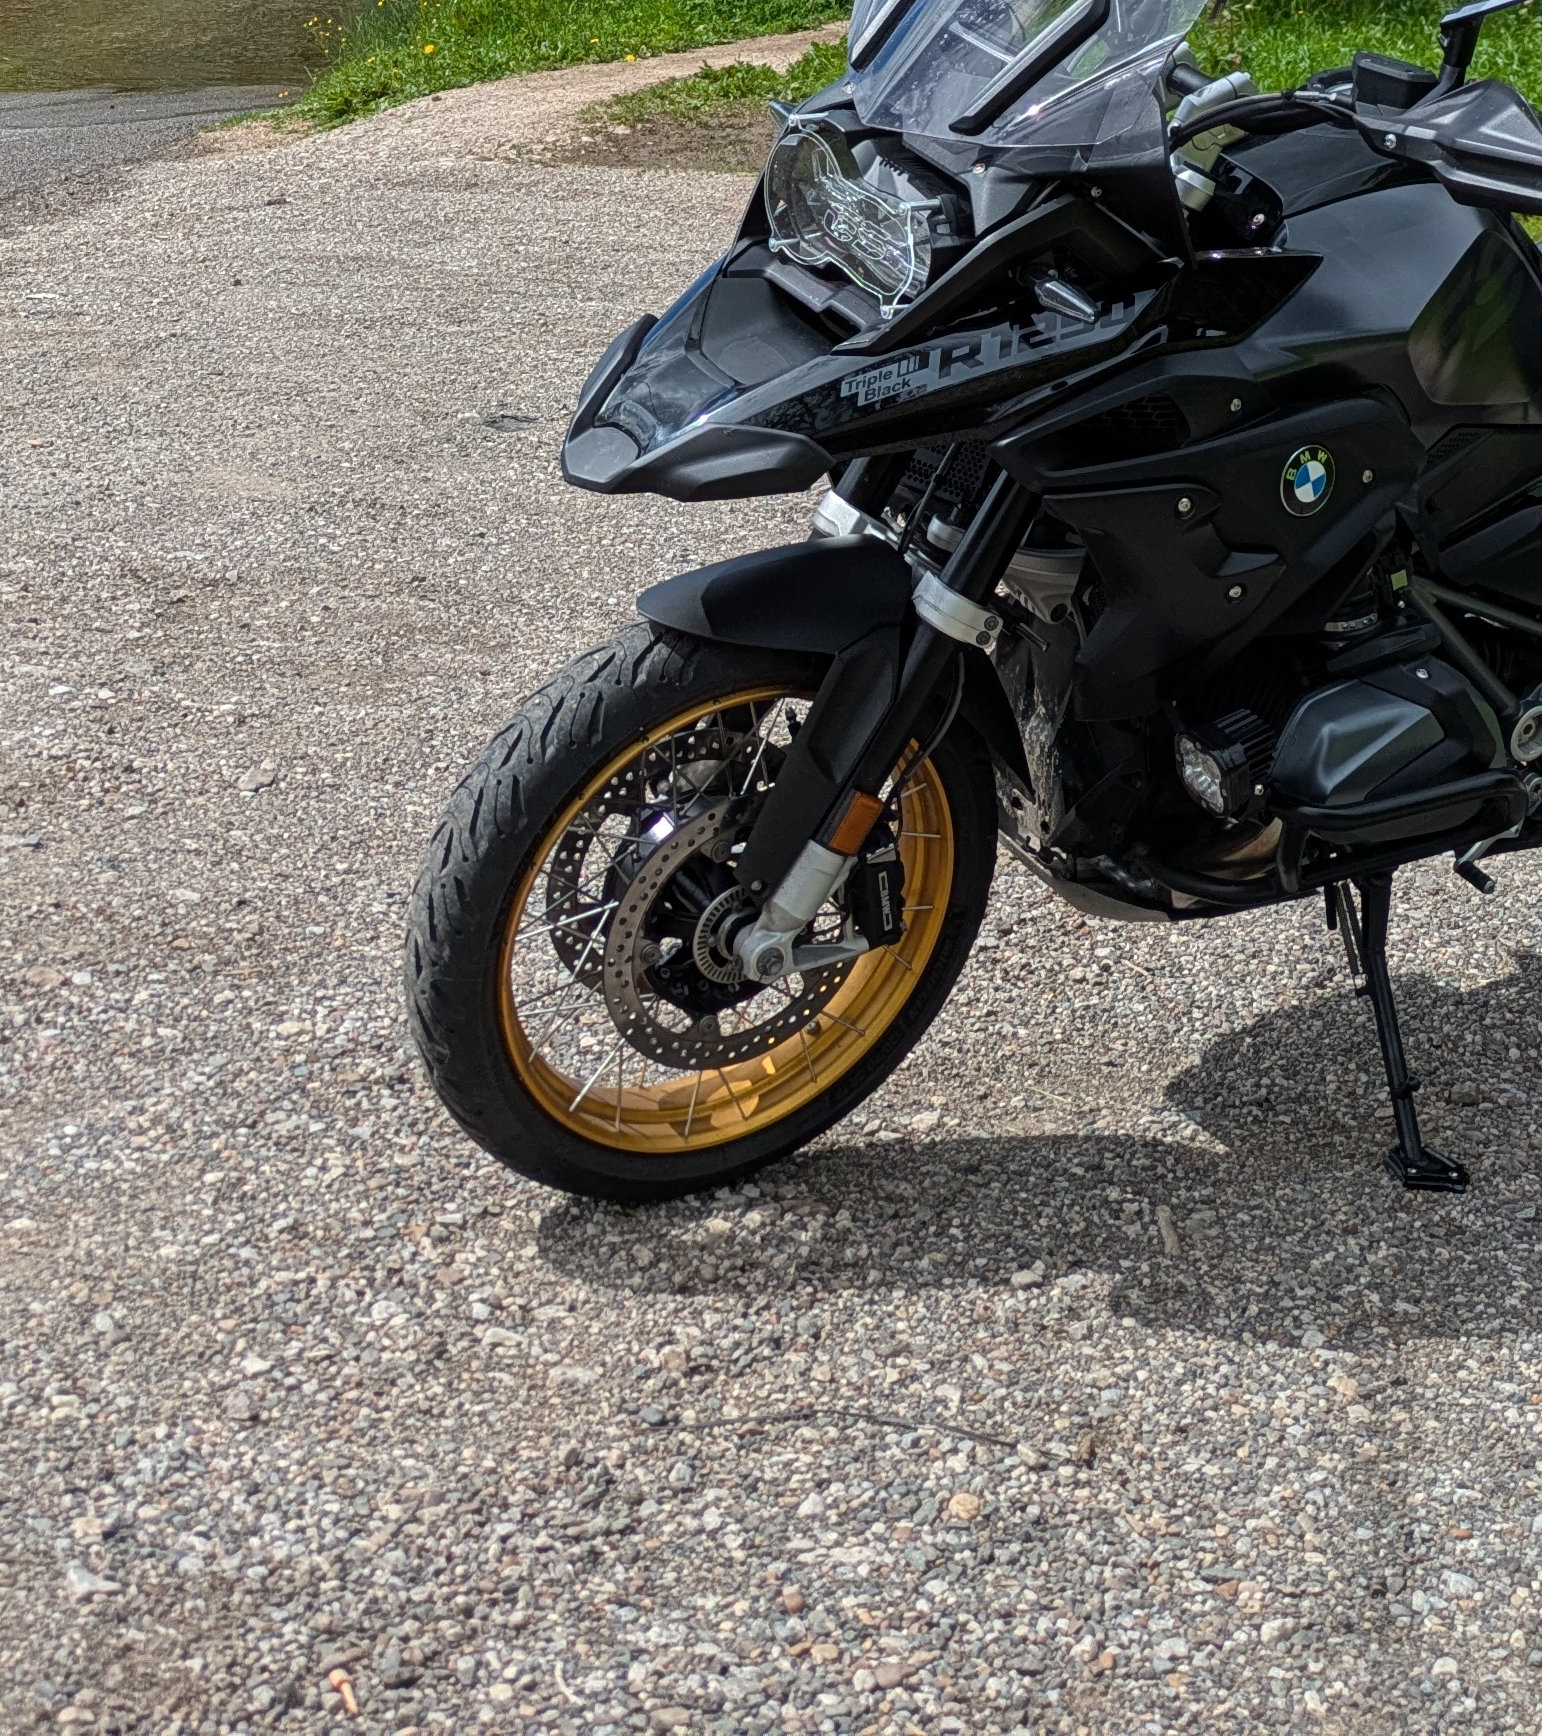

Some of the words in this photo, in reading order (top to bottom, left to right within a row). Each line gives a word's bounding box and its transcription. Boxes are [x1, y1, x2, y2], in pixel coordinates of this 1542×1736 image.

[844, 370, 893, 393] Triple
[864, 377, 911, 402] Black
[1286, 450, 1328, 481] BMW
[880, 889, 891, 914] BMW
